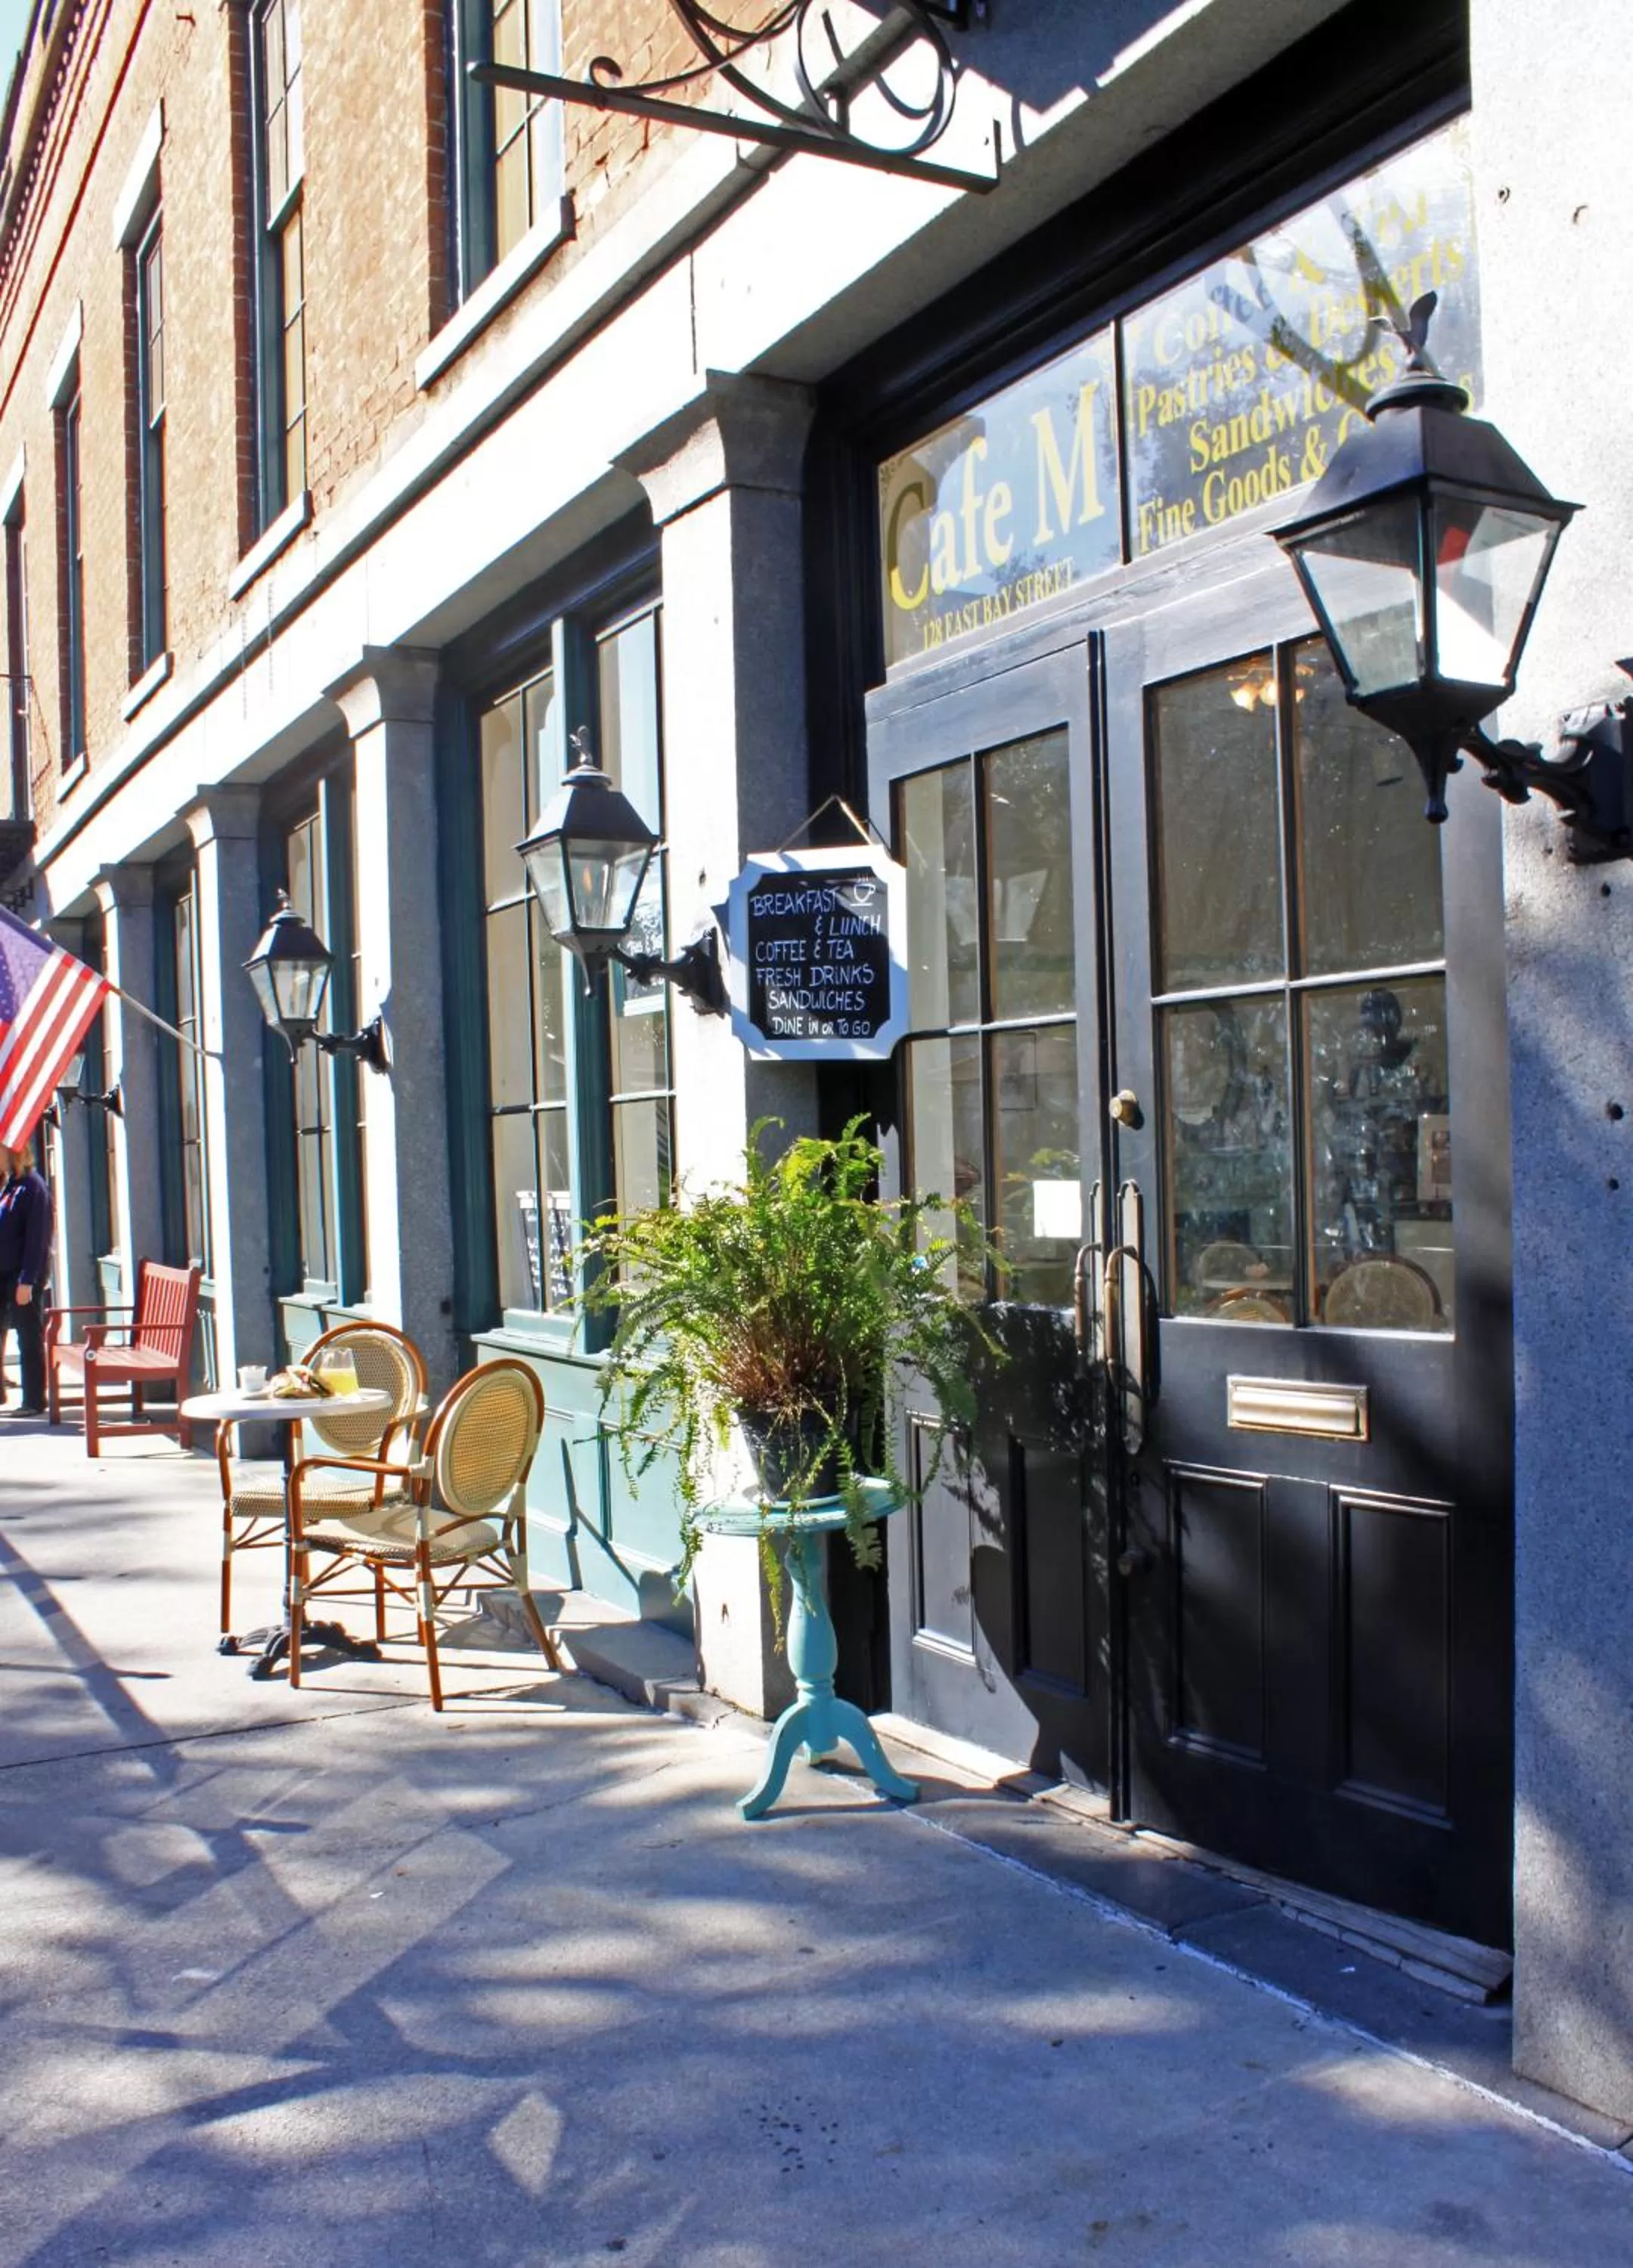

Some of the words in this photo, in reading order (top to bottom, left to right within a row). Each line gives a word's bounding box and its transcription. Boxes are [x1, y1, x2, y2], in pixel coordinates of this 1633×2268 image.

[1138, 344, 1257, 436] Pastries
[1189, 342, 1396, 473] Sandwiches
[887, 436, 1014, 610] Cafe
[1032, 380, 1105, 547] M
[1137, 497, 1197, 557] Fine
[1202, 445, 1293, 525] Goods
[1300, 426, 1328, 479] &
[945, 600, 981, 640] EAST
[983, 584, 1013, 627] BAY
[1015, 556, 1074, 608] STREET
[749, 886, 841, 917] BREAKFAST
[814, 915, 823, 937] &
[829, 913, 882, 937] LUNCH
[756, 940, 807, 961] COFFEE
[813, 938, 823, 959] &
[826, 940, 855, 960] TEA
[755, 967, 801, 987] FRESH
[767, 990, 866, 1012] SANDWICHES
[852, 1022, 871, 1036] GO
